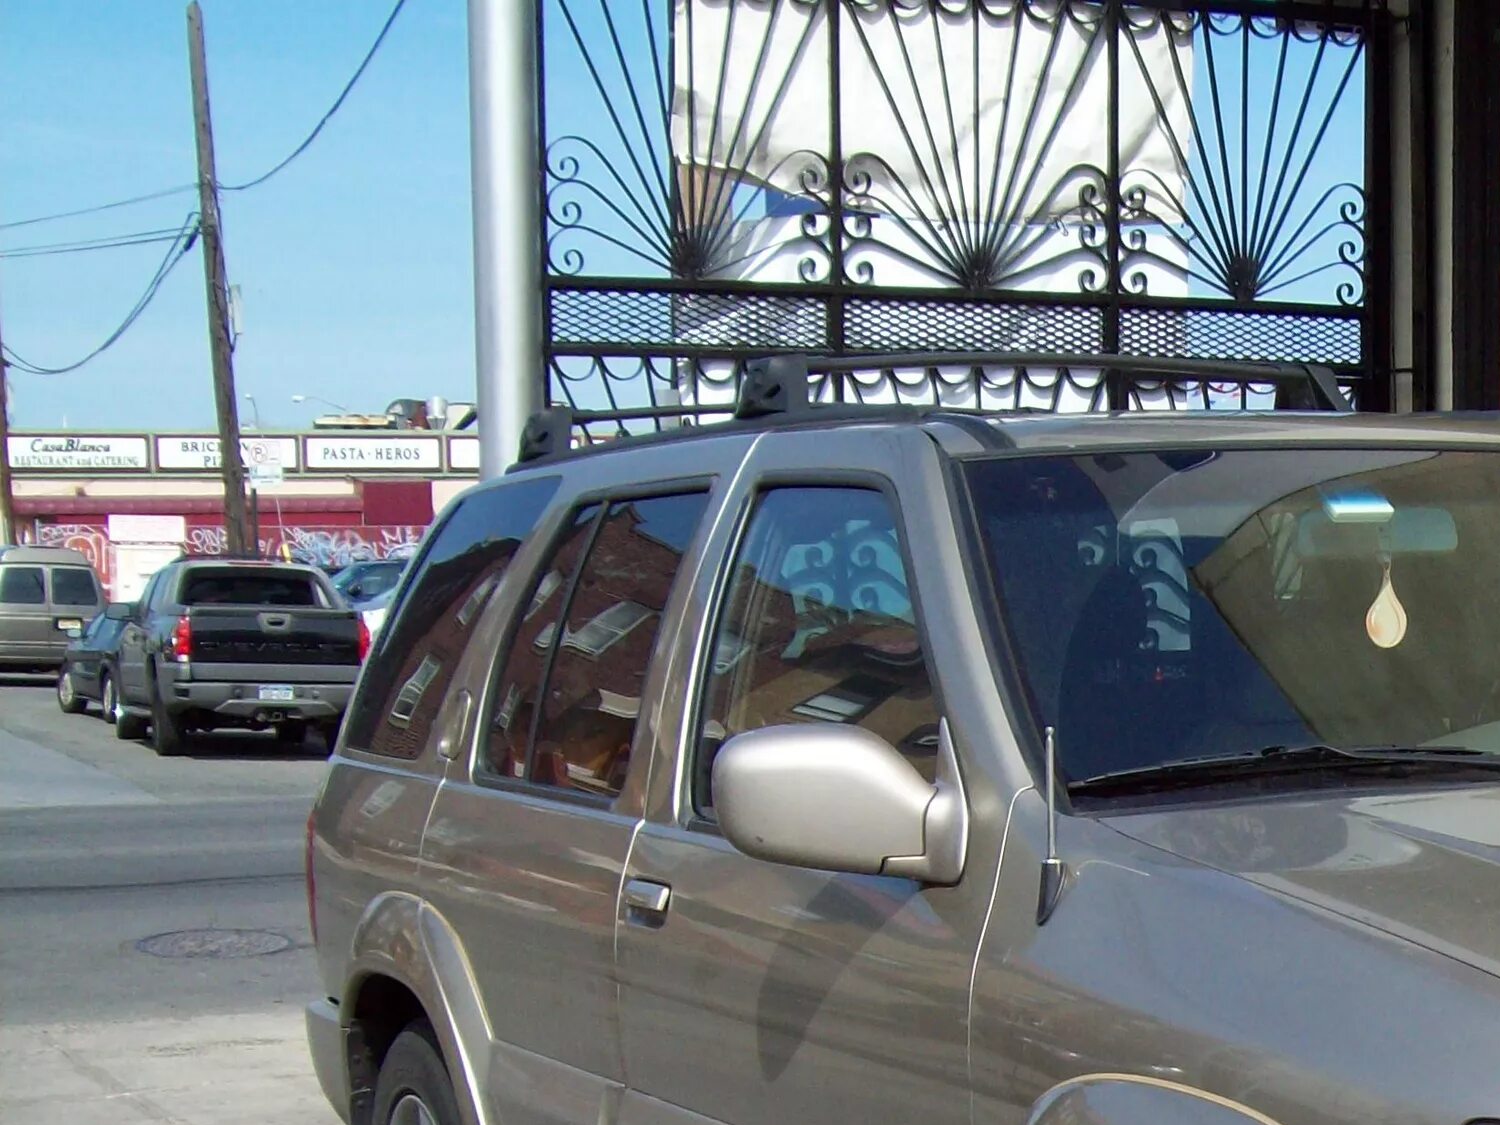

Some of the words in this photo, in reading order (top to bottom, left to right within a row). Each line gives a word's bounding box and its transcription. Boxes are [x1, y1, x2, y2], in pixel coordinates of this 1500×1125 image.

[181, 441, 222, 452] BRIC
[323, 447, 365, 460] PASTA
[375, 447, 421, 460] HEROS
[14, 456, 74, 466] RESTAURANT
[94, 456, 139, 466] CATERING
